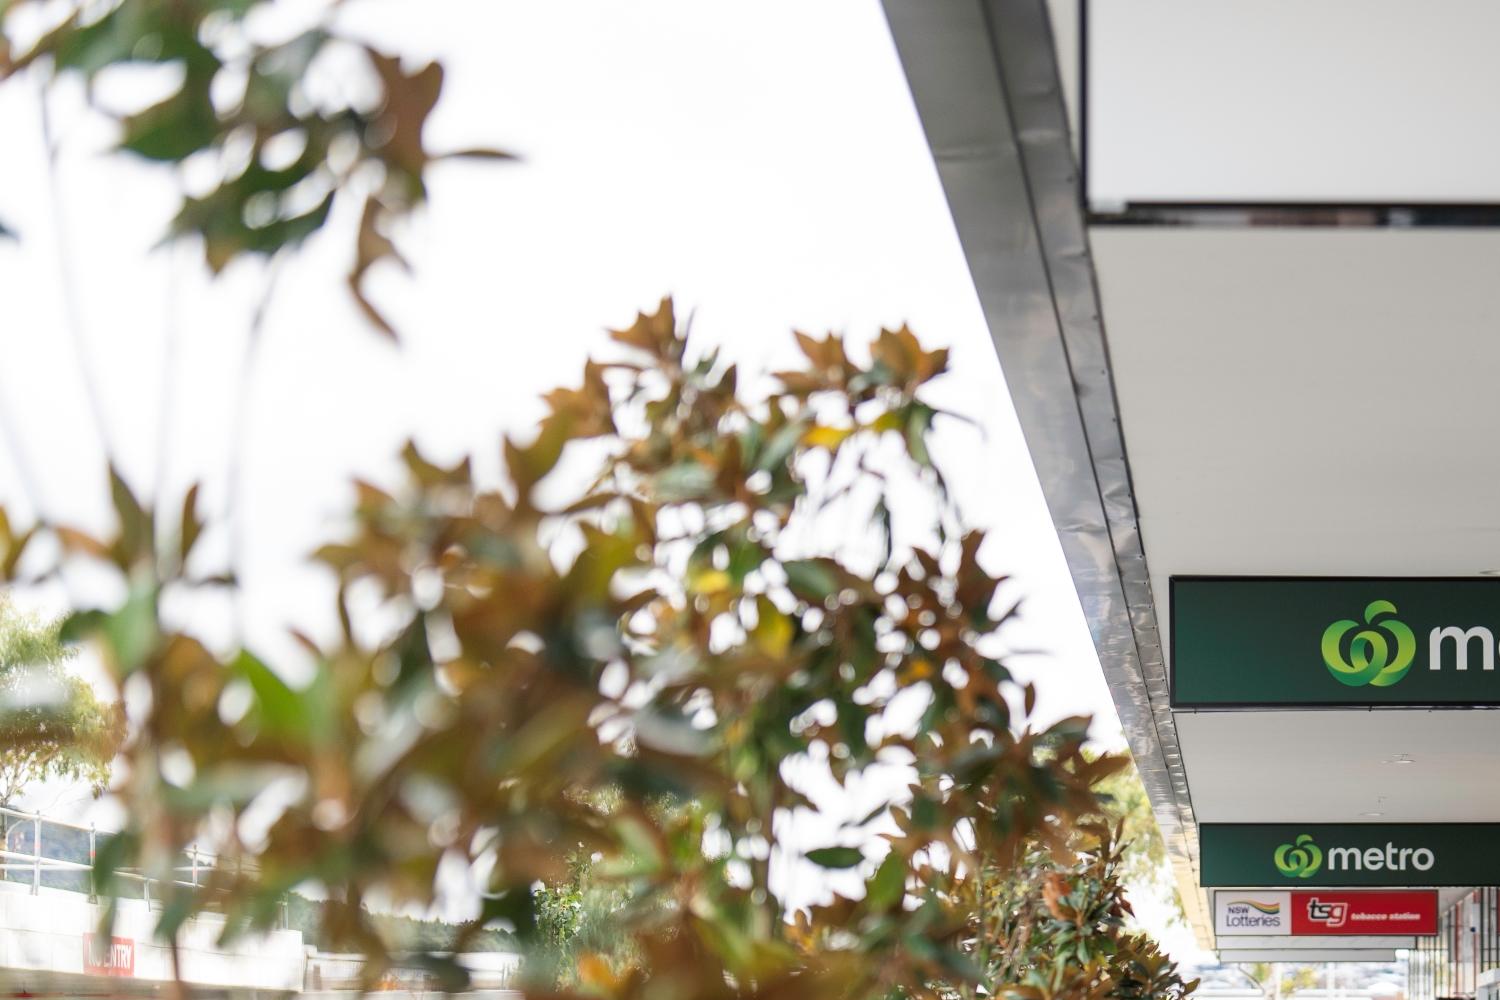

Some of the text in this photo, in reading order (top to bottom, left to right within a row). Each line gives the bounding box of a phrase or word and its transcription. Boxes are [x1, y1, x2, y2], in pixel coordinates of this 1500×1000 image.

[1328, 841, 1435, 871] metro
[1226, 914, 1281, 927] Lotteries
[1228, 906, 1249, 914] NSW
[1306, 897, 1348, 927] tsg
